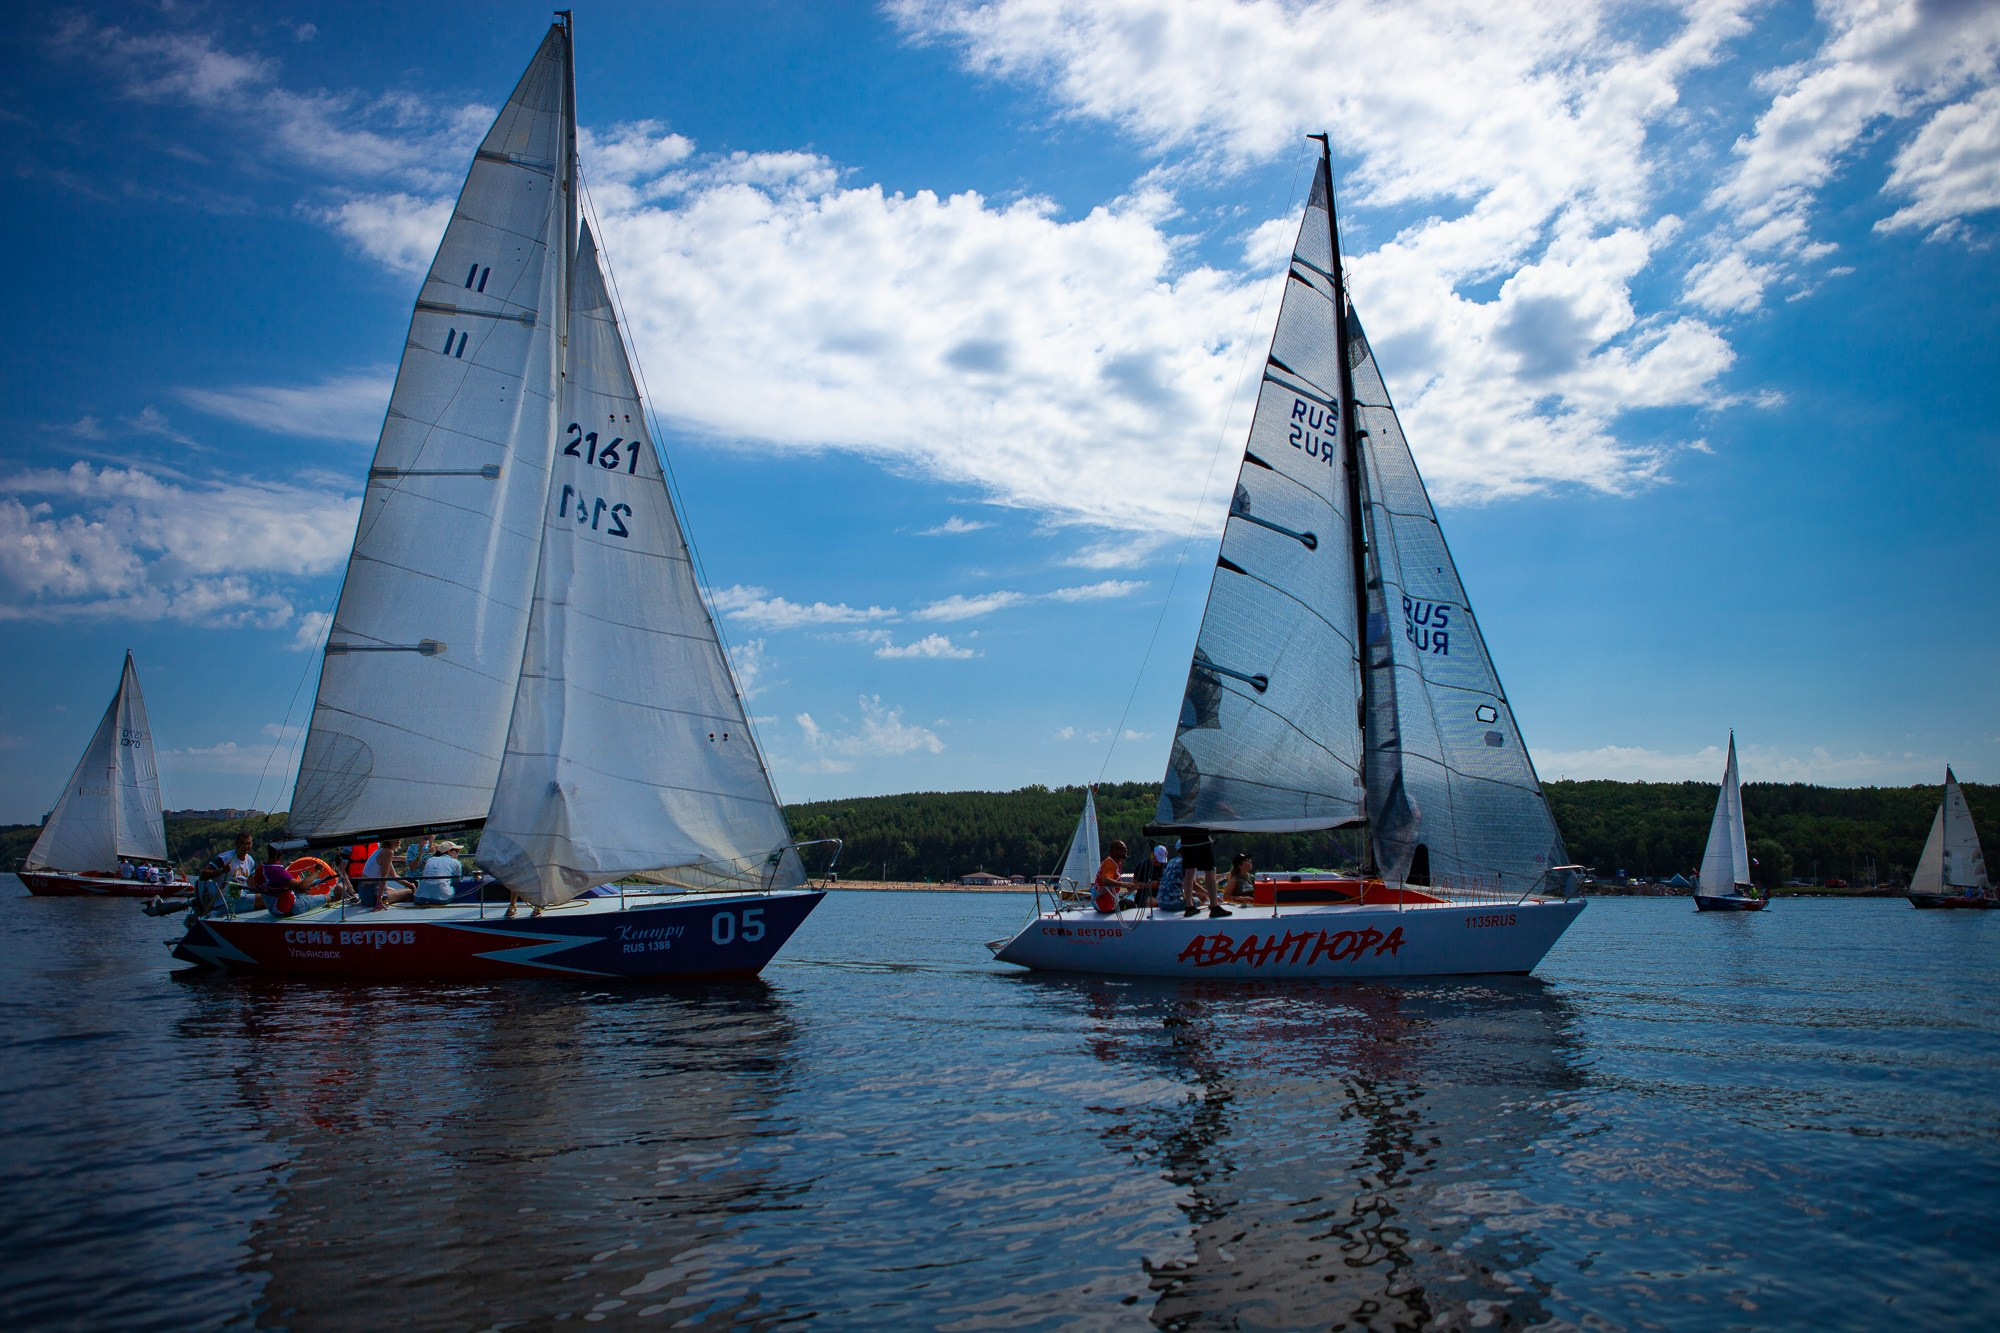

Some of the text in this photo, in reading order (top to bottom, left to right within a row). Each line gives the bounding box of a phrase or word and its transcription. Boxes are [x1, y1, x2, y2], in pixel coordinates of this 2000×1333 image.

[1291, 398, 1338, 437] RUS
[564, 423, 641, 475] 2161
[1402, 596, 1451, 629] RUS
[120, 739, 140, 748] 1370
[711, 908, 766, 945] 05
[1465, 914, 1517, 928] 1135RUS
[284, 930, 416, 949] семь ветров
[1077, 928, 1123, 940] ветров
[288, 947, 341, 959] Ульяновск
[623, 940, 671, 954] RUS 1388
[1176, 923, 1409, 969] АВАНТЮРА
